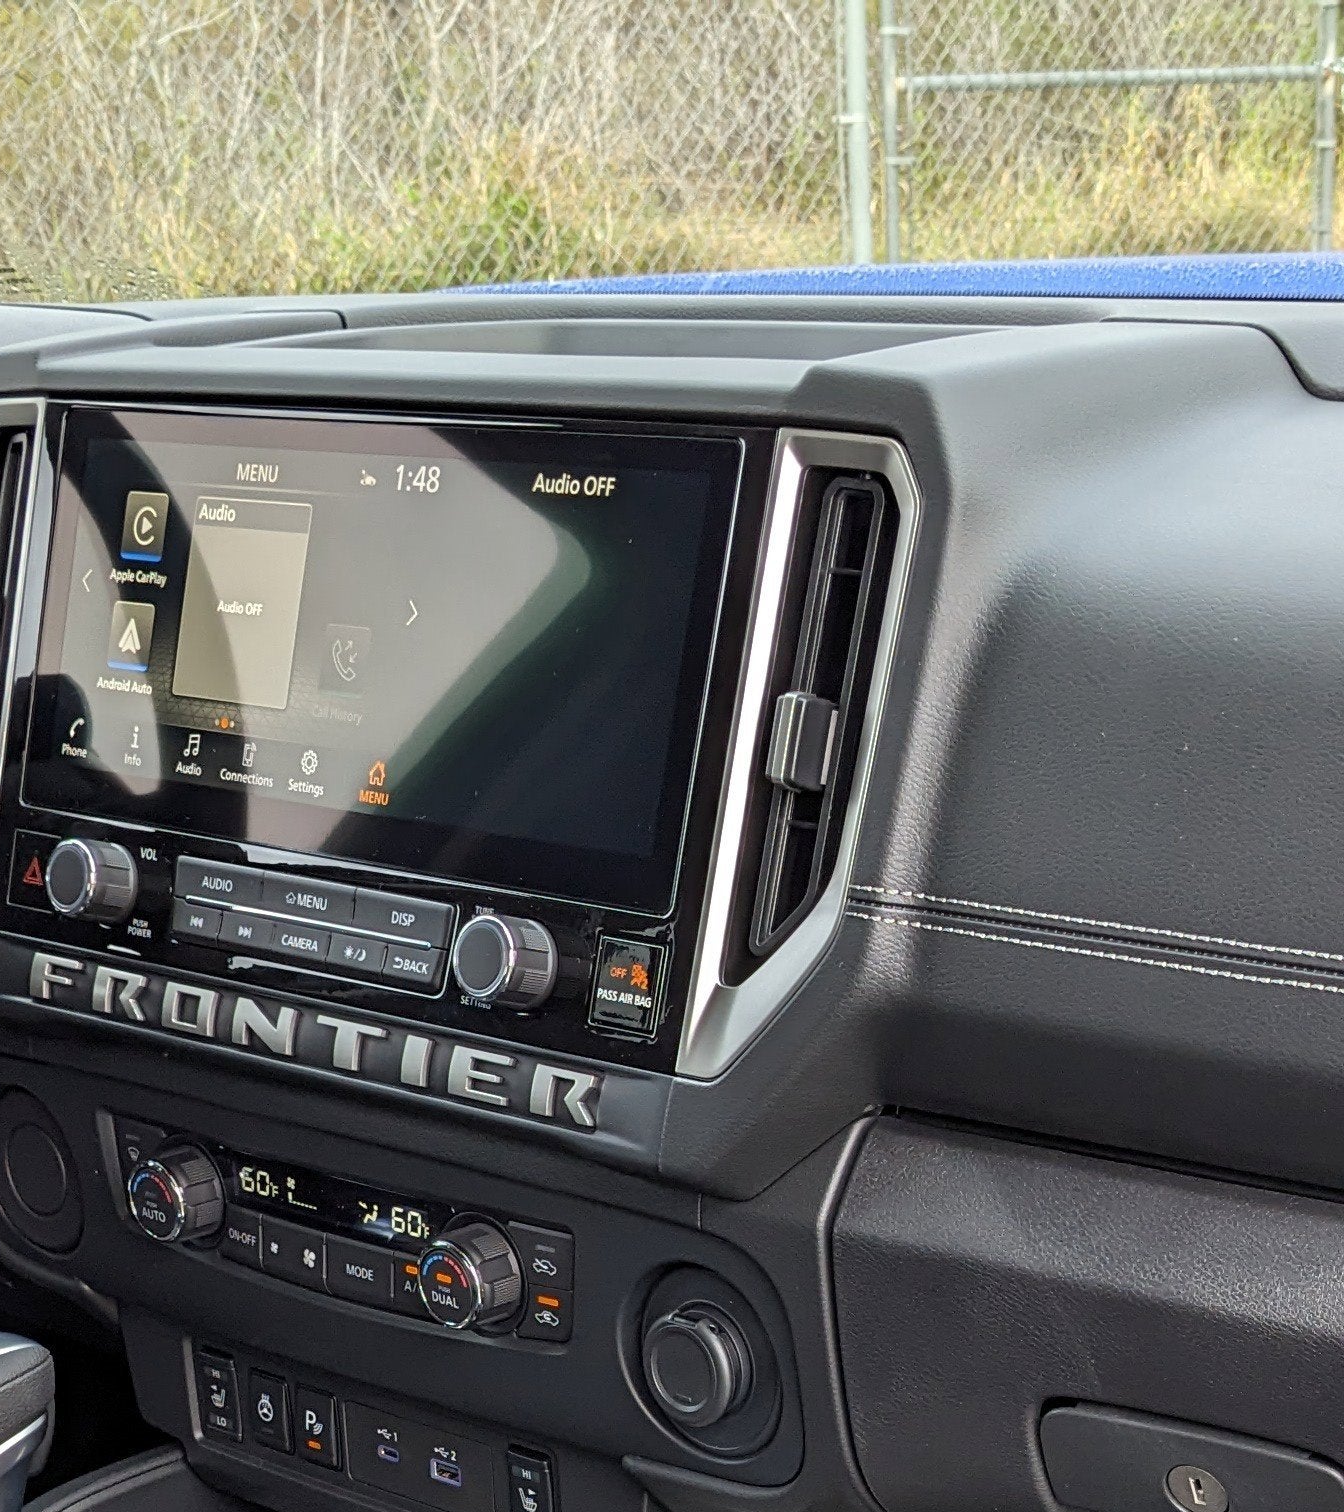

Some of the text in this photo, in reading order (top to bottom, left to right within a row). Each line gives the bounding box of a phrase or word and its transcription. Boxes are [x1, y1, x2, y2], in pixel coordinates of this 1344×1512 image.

[236, 463, 279, 483] MENU
[396, 465, 441, 493] 1:48
[531, 472, 616, 497] Audio OFF
[199, 503, 236, 522] Audio
[110, 568, 167, 588] Apple CarPlay
[216, 600, 263, 616] Audio OFF
[96, 677, 153, 695] Android Auto
[61, 743, 87, 758] Phone
[125, 753, 142, 766] Info
[175, 761, 202, 776] Audio
[220, 769, 274, 788] Connections
[288, 778, 324, 798] Settings
[358, 790, 389, 806] MENU
[140, 847, 158, 861] VOL
[202, 875, 233, 893] AUDIO
[297, 893, 328, 911] MENU
[391, 910, 415, 927] DISP
[127, 925, 152, 939] POWER
[281, 934, 318, 952] CAMERA
[402, 960, 429, 975] BACK
[610, 967, 627, 979] OFF
[597, 988, 652, 1009] PASS AIR BAG
[29, 951, 604, 1133] FRONTIER
[142, 1207, 166, 1223] AUTO
[345, 1263, 374, 1283] MODE
[404, 1279, 418, 1293] A/
[431, 1290, 460, 1310] DUAL
[216, 1416, 227, 1427] LO
[450, 1450, 457, 1462] 2
[522, 1469, 532, 1480] HI
